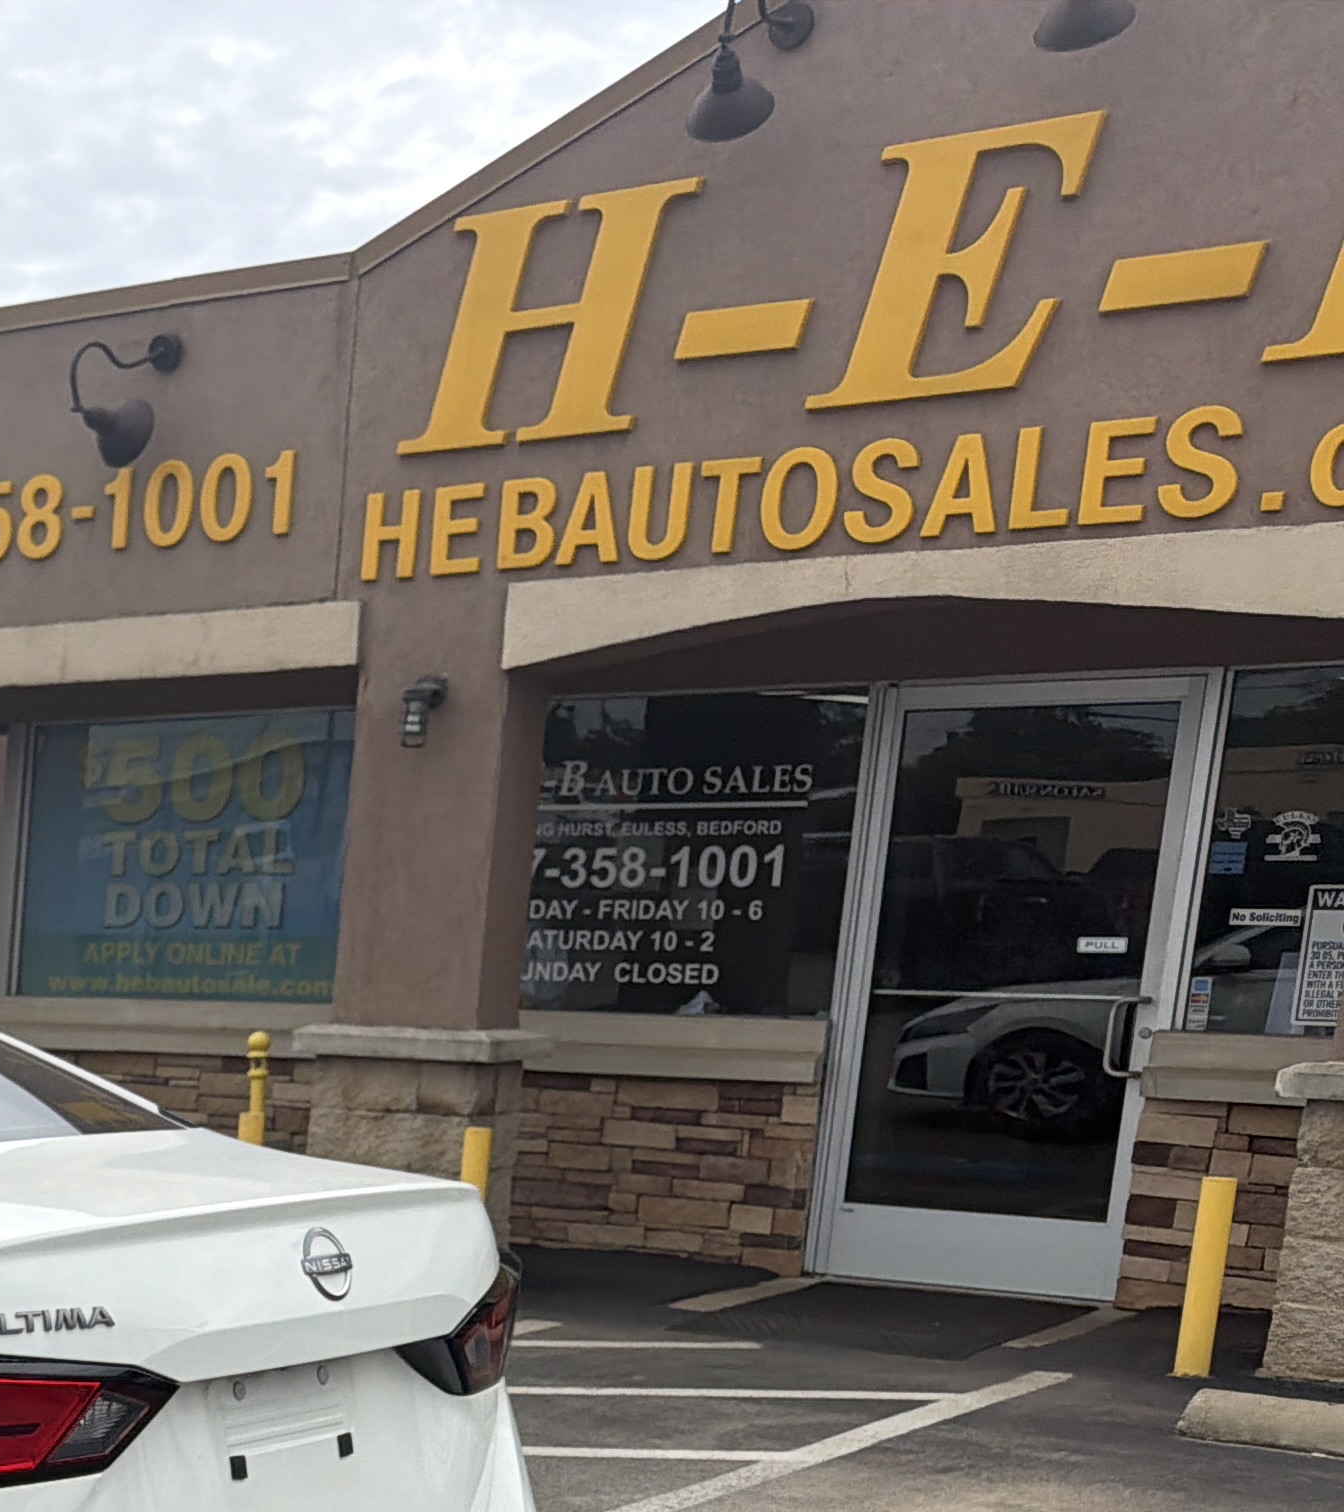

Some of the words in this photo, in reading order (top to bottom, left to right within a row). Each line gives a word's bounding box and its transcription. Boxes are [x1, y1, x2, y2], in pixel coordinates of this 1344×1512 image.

[397, 110, 1344, 456] H-E-
[594, 766, 694, 797] AUTO
[703, 764, 814, 795] SALES
[622, 821, 692, 838] EULESS,
[696, 819, 783, 837] BEDFORD
[100, 824, 295, 879] TOTAL
[103, 881, 286, 931] DOWN
[528, 899, 579, 920] DAY
[597, 899, 690, 921] FRIDAY
[697, 899, 725, 921] 10
[747, 899, 763, 921] 6
[1232, 912, 1247, 922] No
[1248, 911, 1300, 925] Soliciting
[526, 929, 644, 952] ATURDAY
[650, 930, 678, 952] 10
[699, 930, 715, 952] 2
[1085, 940, 1120, 950] PULL
[83, 942, 159, 966] APPLY
[166, 942, 262, 967] ONLINE
[269, 943, 303, 967] AT
[613, 962, 720, 985] CLOSED
